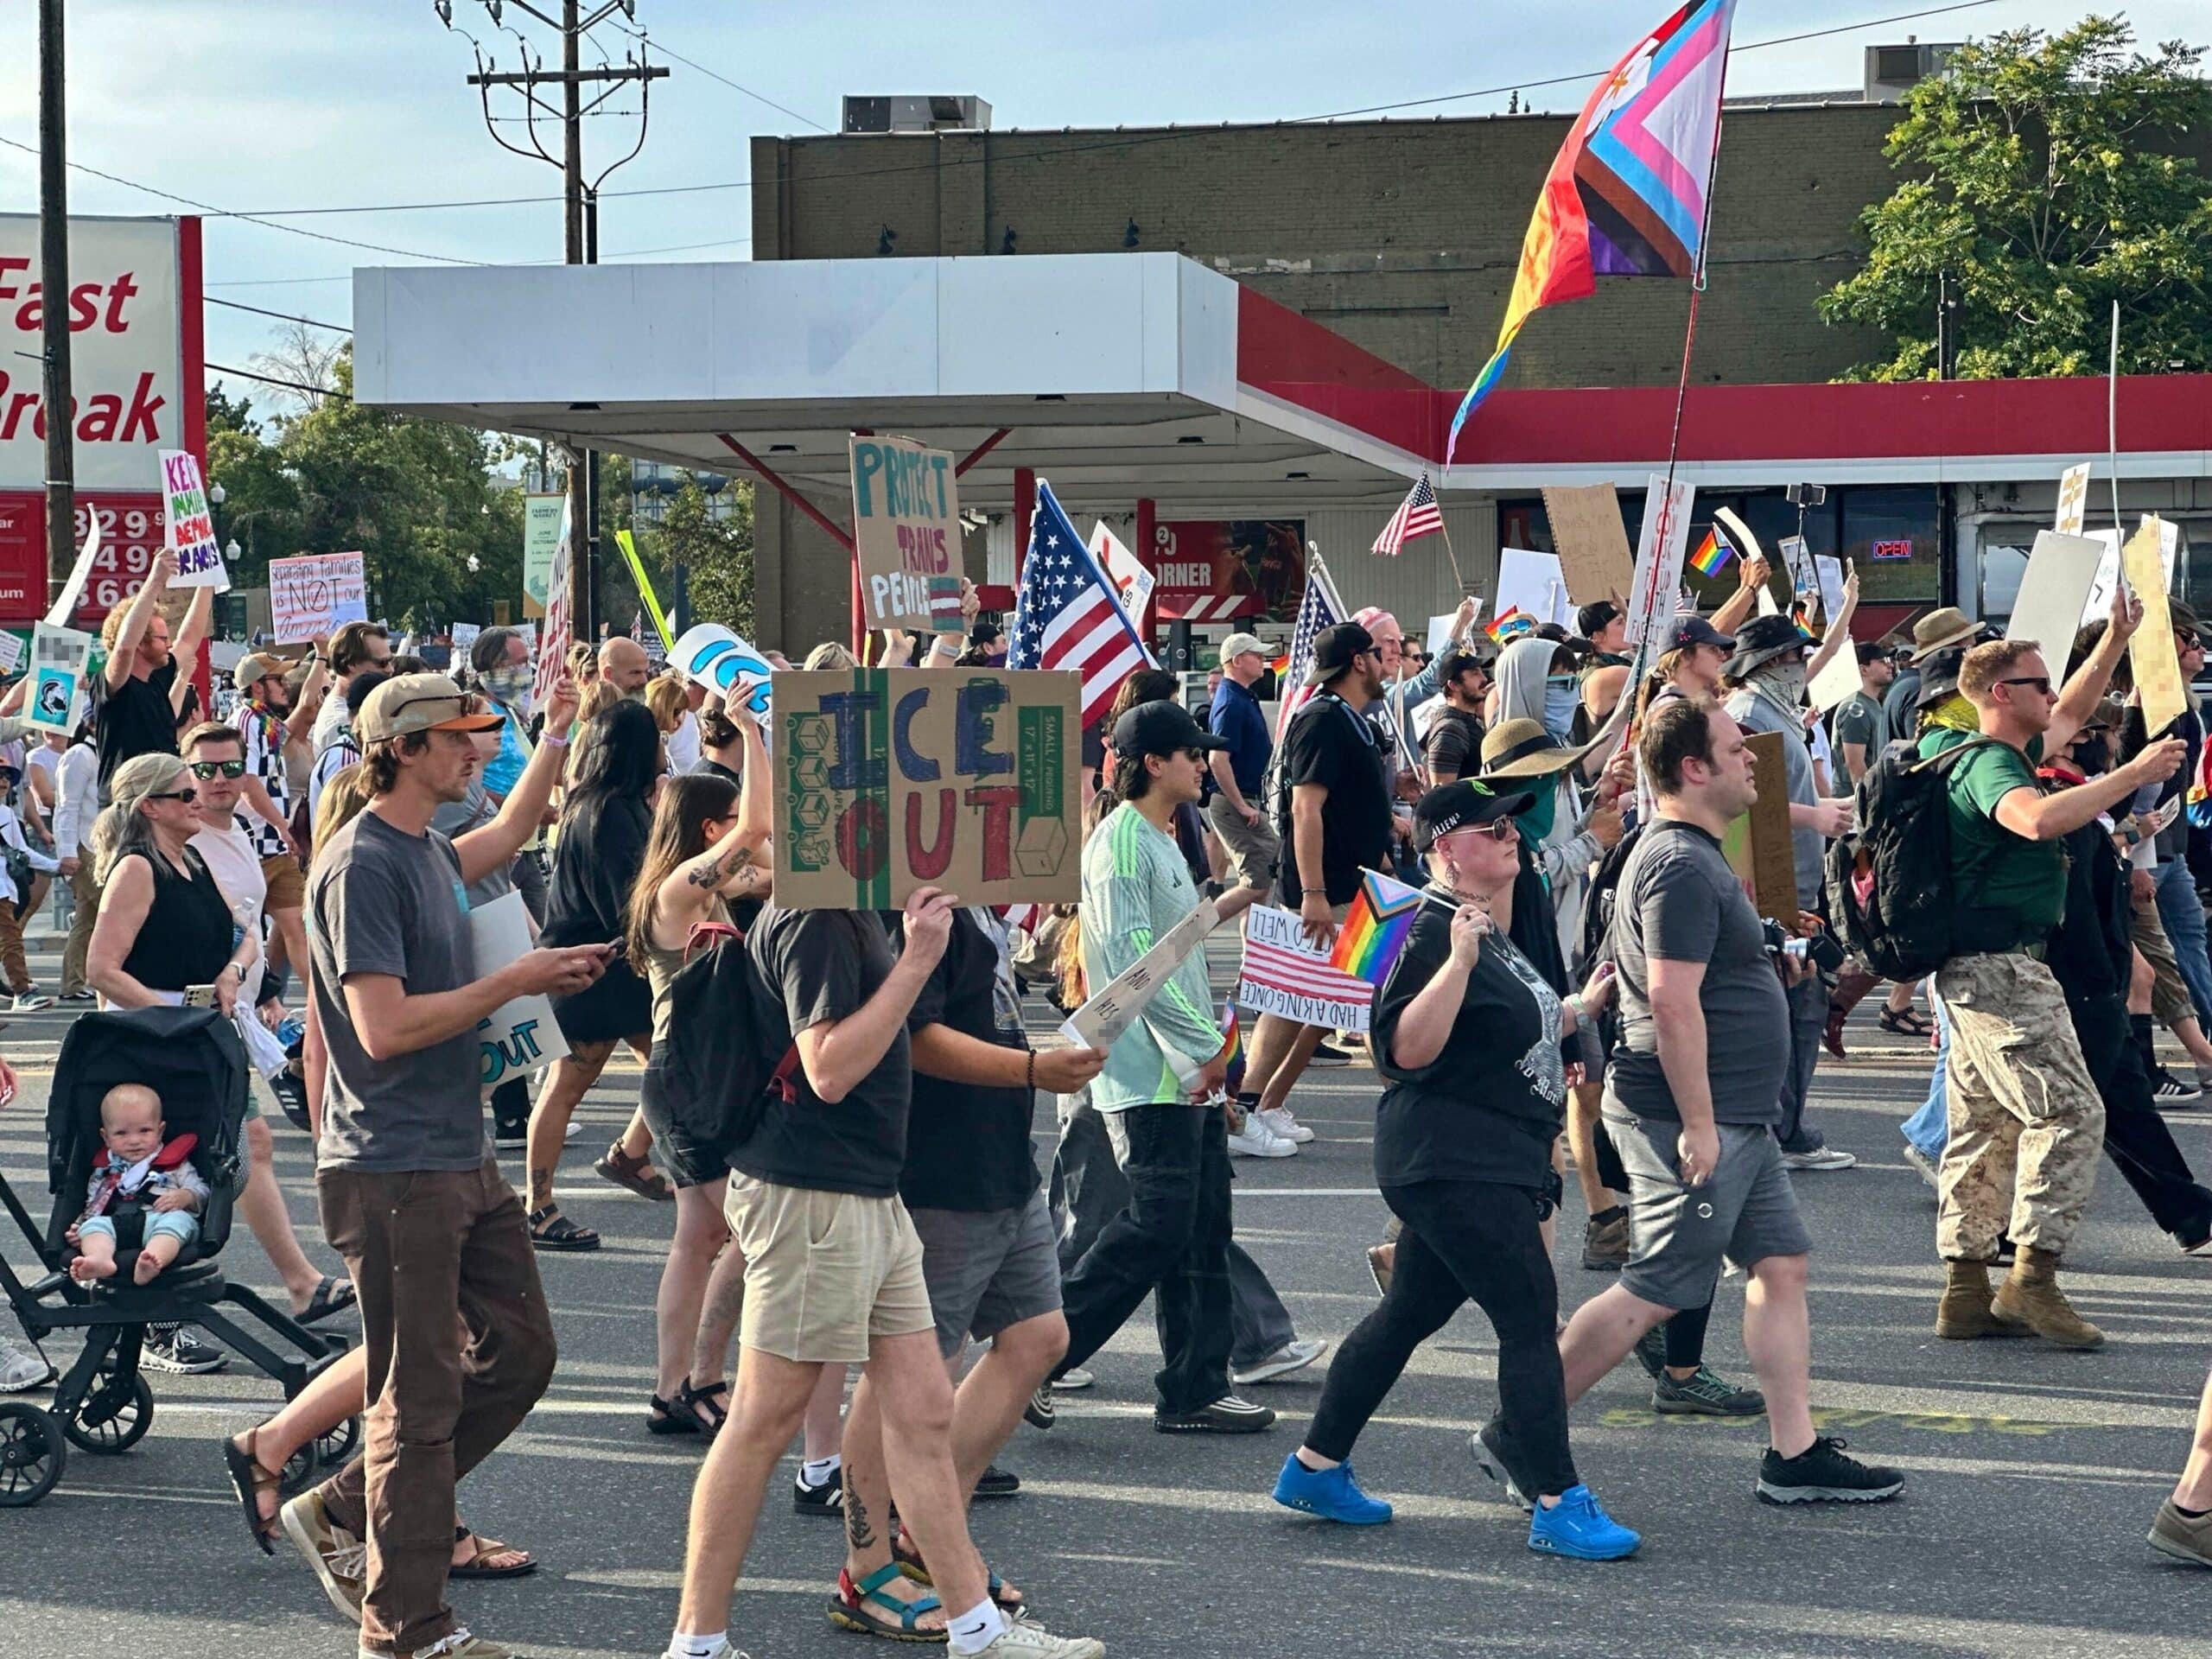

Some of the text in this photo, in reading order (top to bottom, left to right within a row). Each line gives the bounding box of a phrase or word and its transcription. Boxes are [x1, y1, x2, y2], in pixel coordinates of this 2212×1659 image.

[855, 442, 949, 518] PROTECT
[897, 524, 950, 575] TRANS
[1875, 543, 1910, 557] OPEN
[320, 556, 360, 578] families
[289, 578, 341, 613] NOT
[871, 571, 931, 619] PEOPLE
[818, 684, 1014, 790] ICE
[836, 785, 1024, 881] OUT
[1253, 911, 1288, 941] WELL
[1124, 967, 1151, 990] AND
[1093, 997, 1120, 1020] HIS
[1243, 982, 1276, 1014] ONCE
[1277, 992, 1313, 1020] KING
[1330, 999, 1357, 1028] HAD
